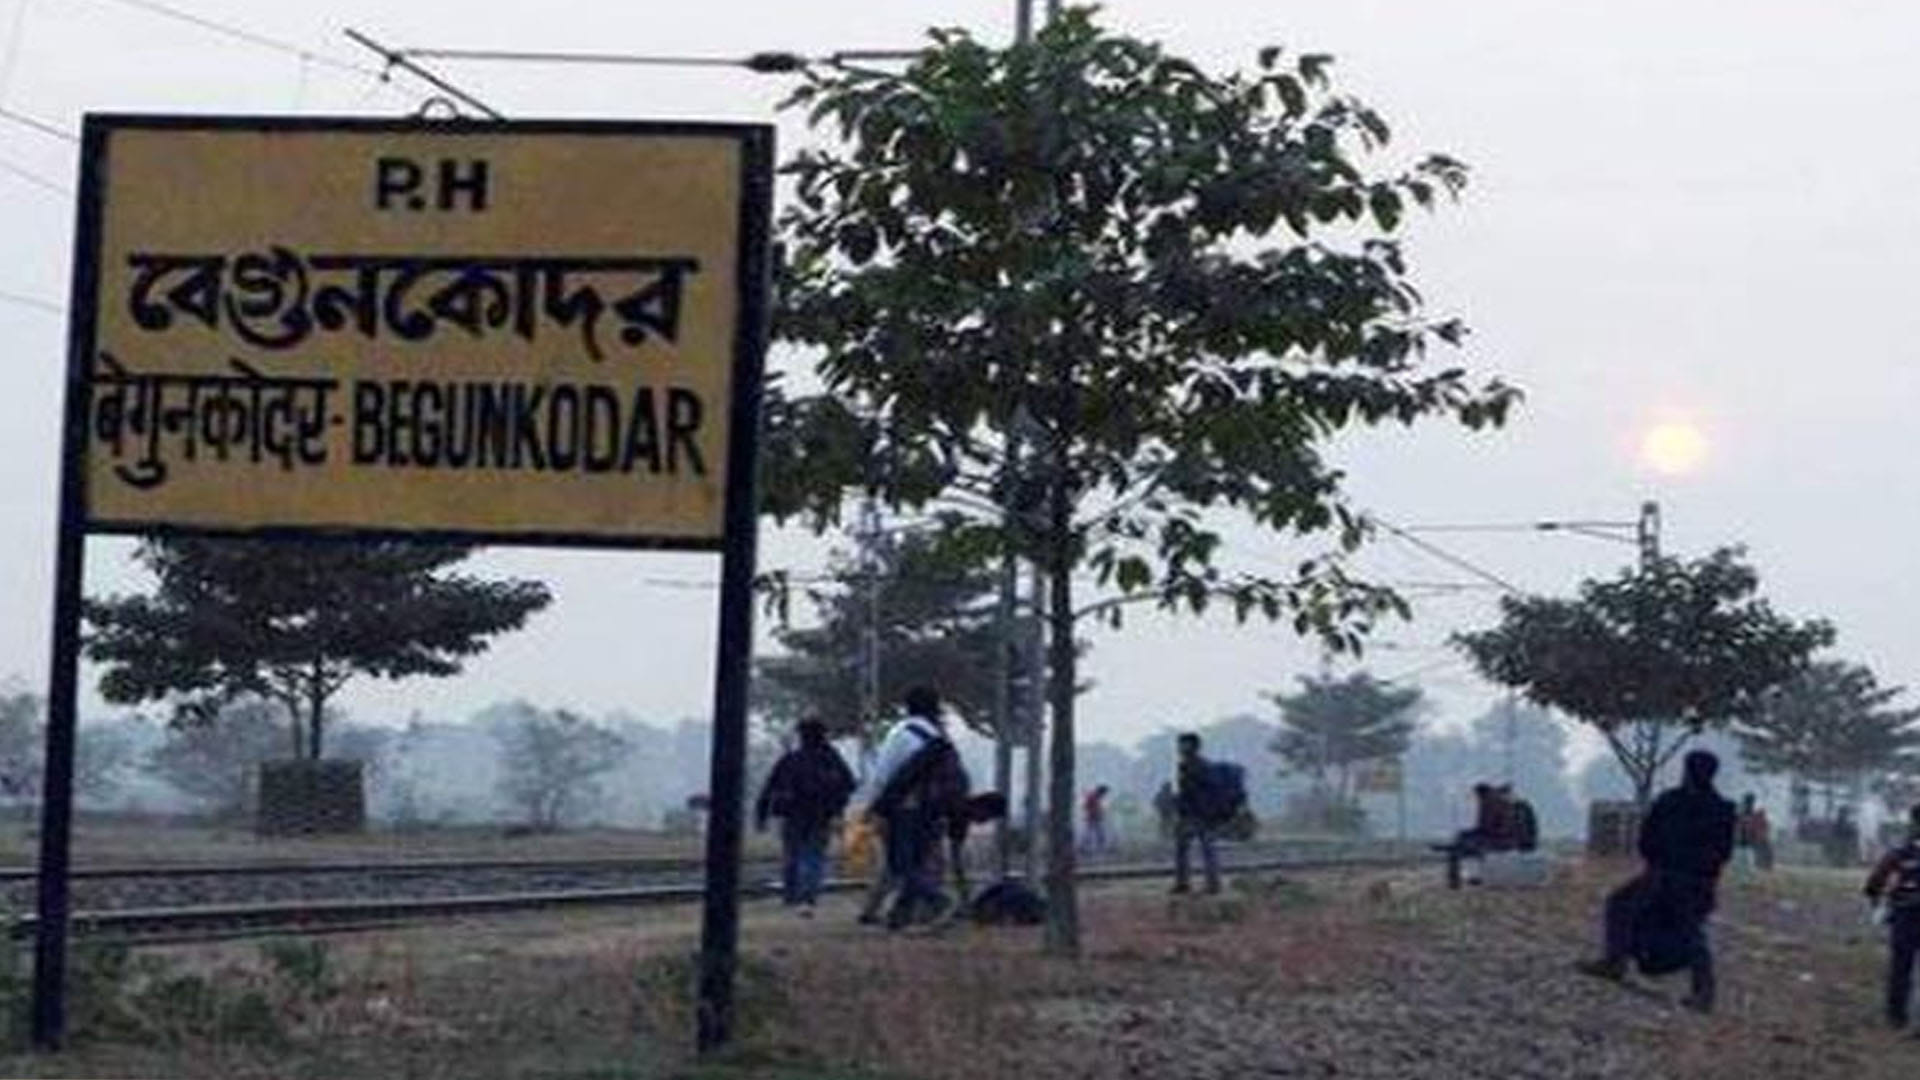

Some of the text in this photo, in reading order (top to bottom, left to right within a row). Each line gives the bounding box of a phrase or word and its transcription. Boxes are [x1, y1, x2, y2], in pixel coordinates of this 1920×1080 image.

[376, 157, 489, 212] P.H
[127, 246, 699, 362] বেগুনকোদর
[353, 378, 706, 476] BEGUNKODAR
